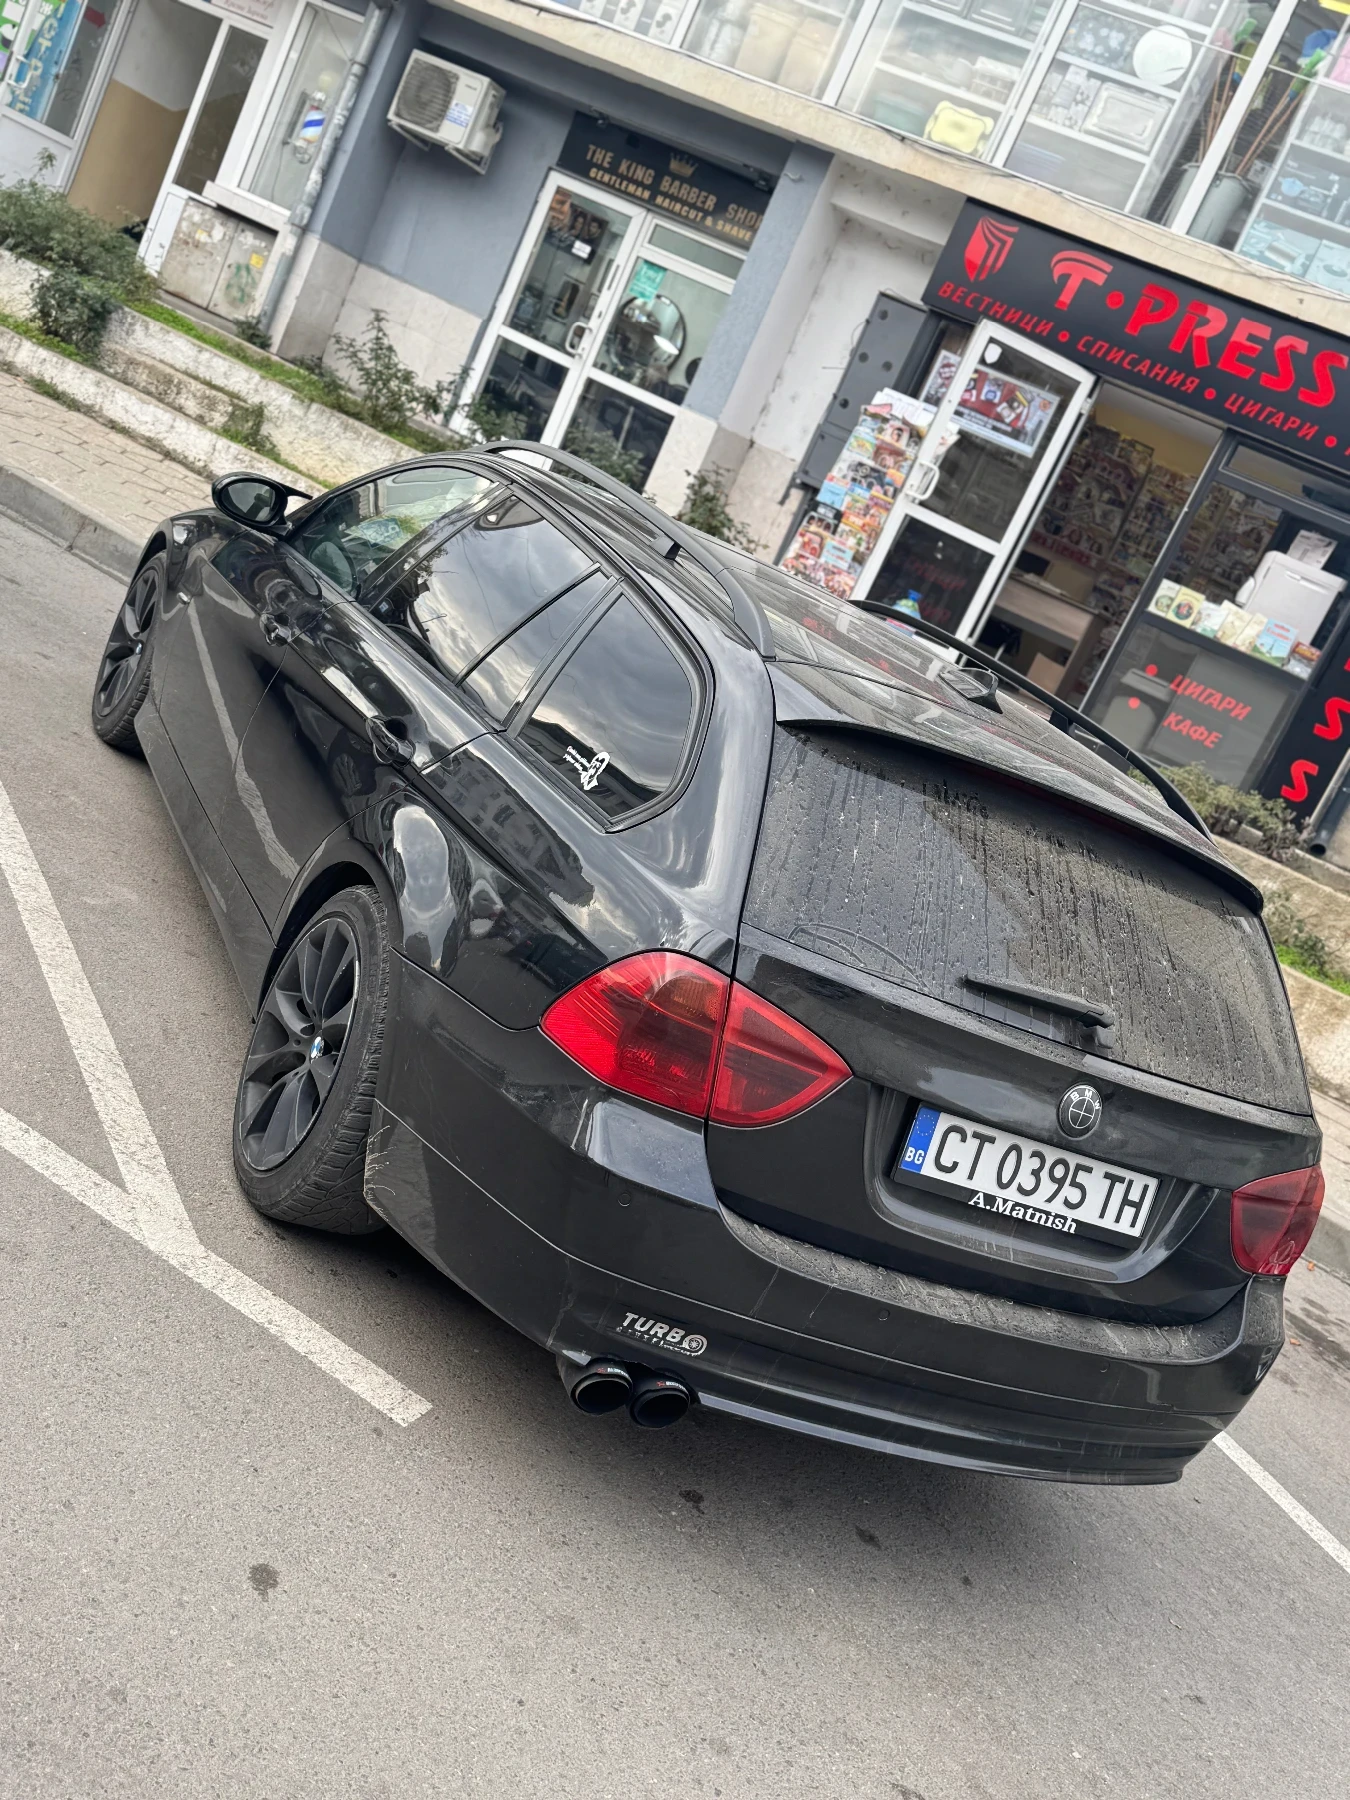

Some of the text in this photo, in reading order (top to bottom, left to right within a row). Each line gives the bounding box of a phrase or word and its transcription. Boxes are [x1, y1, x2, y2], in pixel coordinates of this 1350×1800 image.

[585, 144, 614, 168] THE
[618, 158, 655, 185] KING
[660, 176, 717, 212] BARBER
[589, 167, 753, 241] GENTLEMAN HAIRCUT & SHAVE
[938, 281, 1319, 441] ВЕСТНИЦИ СПИСАНИЯ ЦИГАРИ
[1169, 674, 1252, 722] ЦИГАРИ
[1163, 712, 1223, 749] КАФЕ
[1069, 1088, 1101, 1110] BMW
[904, 1146, 924, 1165] BG
[934, 1124, 1150, 1229] CT 0395 TH
[968, 1191, 1077, 1235] A.Matnish
